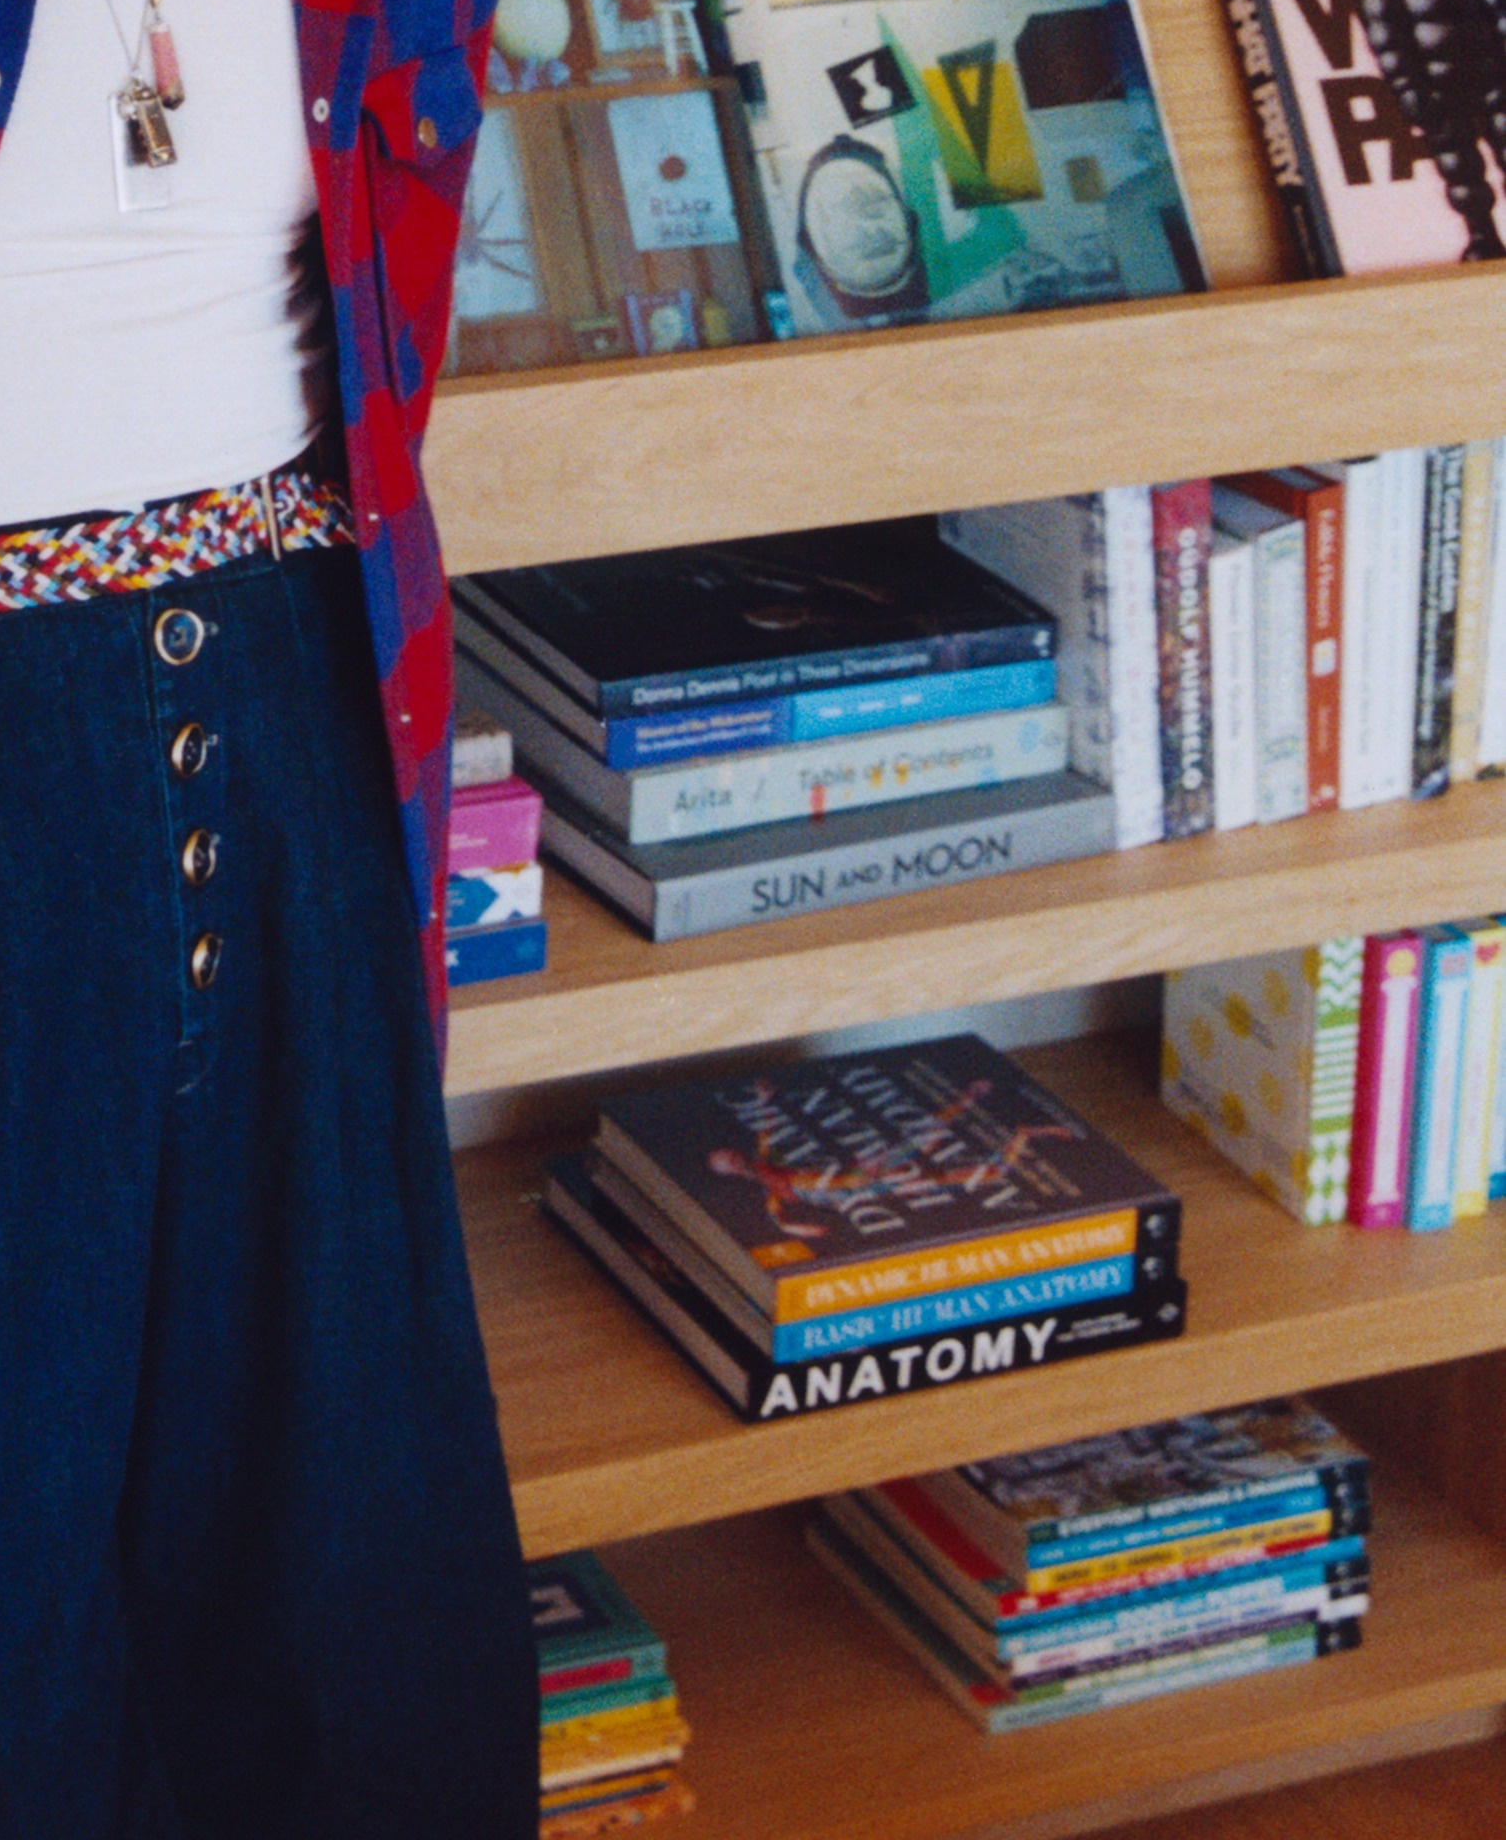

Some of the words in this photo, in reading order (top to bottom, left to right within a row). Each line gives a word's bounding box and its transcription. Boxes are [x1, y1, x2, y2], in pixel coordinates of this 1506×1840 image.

[751, 863, 826, 914] SUN
[838, 861, 882, 890] AND
[891, 831, 1013, 885] MOON
[999, 1264, 1127, 1314] ANATOMY
[760, 1318, 1059, 1418] ANATOMY
